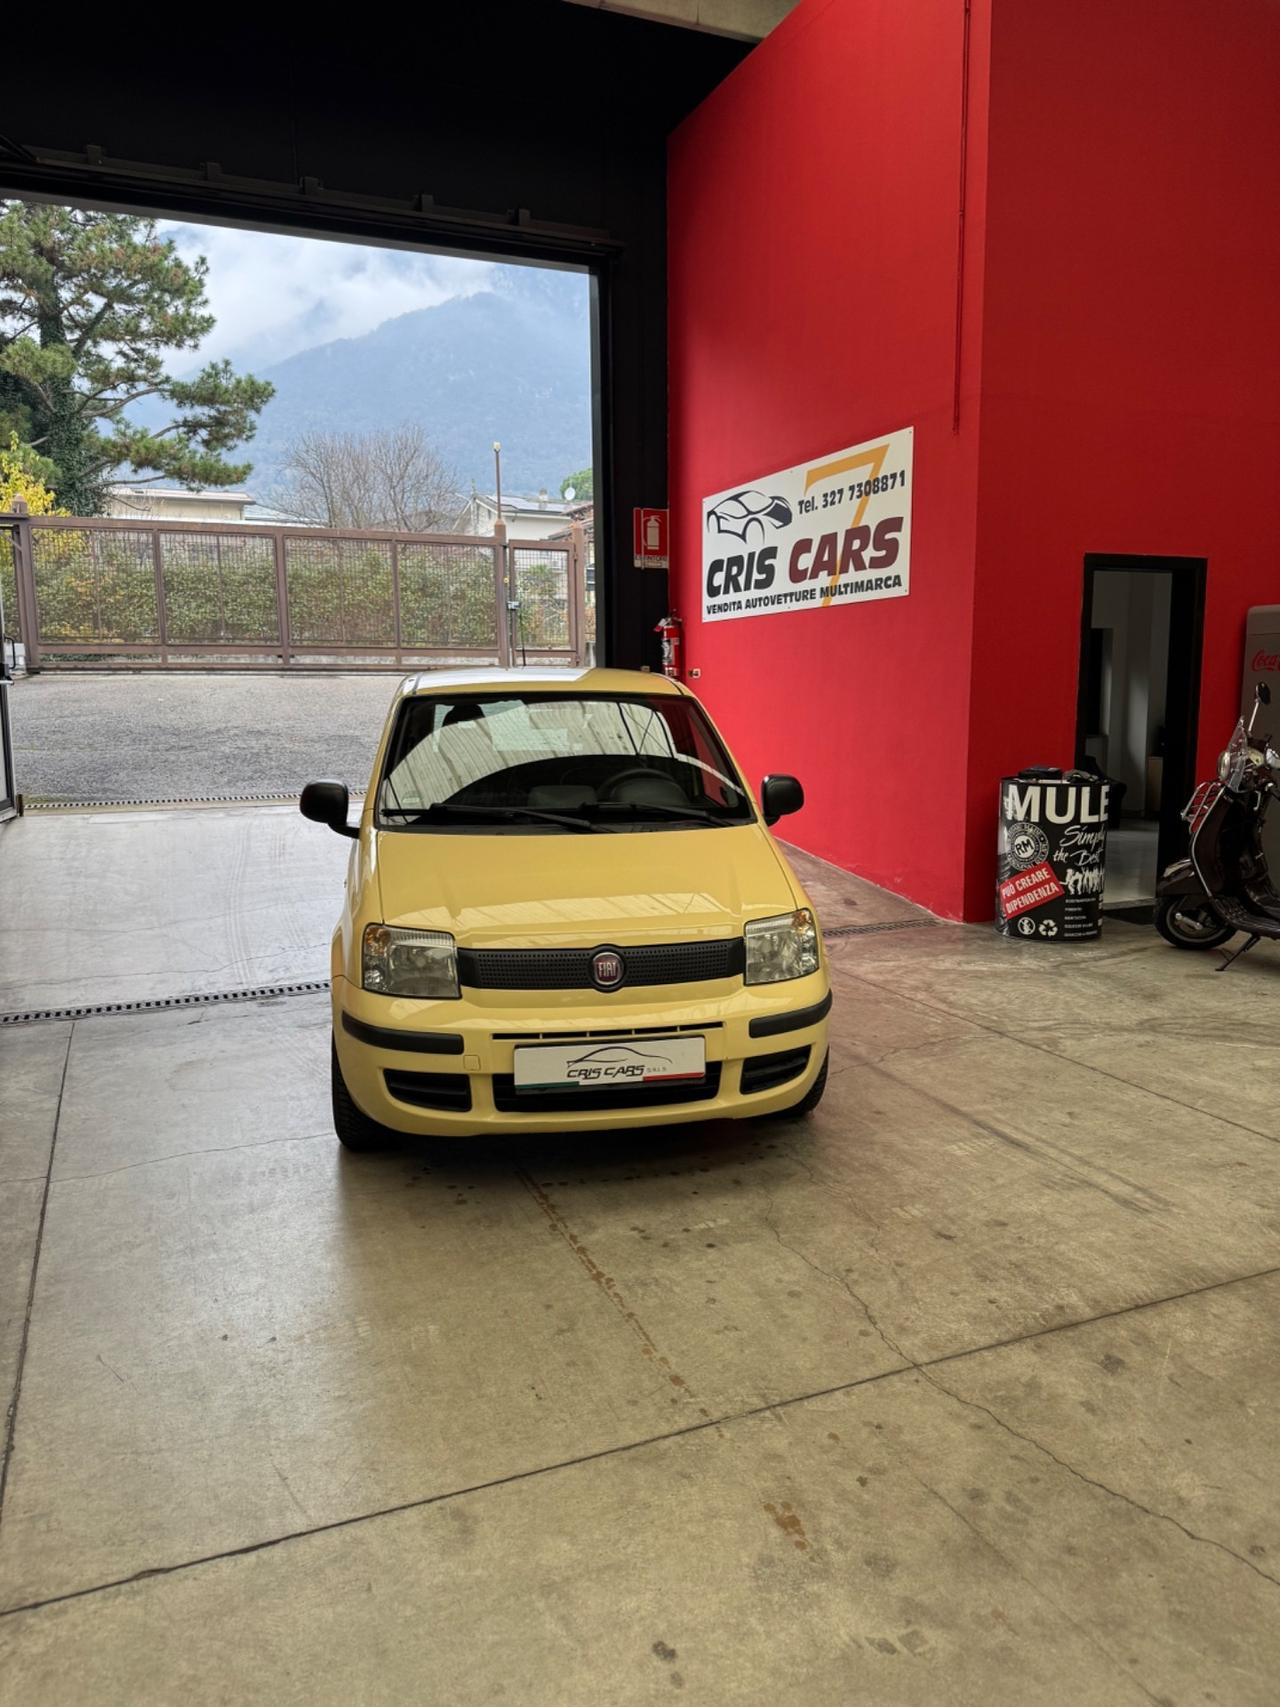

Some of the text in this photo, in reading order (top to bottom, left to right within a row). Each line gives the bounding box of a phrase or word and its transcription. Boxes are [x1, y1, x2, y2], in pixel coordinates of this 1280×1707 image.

[798, 469, 906, 515] Tel. 327 7308871
[706, 516, 904, 599] CRIS CARS
[706, 574, 902, 615] VENDITA AUTOVETTURE MULTIMARCA
[1015, 838, 1034, 856] RM
[1053, 847, 1069, 863] the
[1015, 867, 1051, 891] CREARE
[1005, 882, 1059, 914] DIPENDENZA
[598, 961, 617, 977] FIAT
[567, 1068, 602, 1080] CRIS
[603, 1065, 645, 1078] CARS
